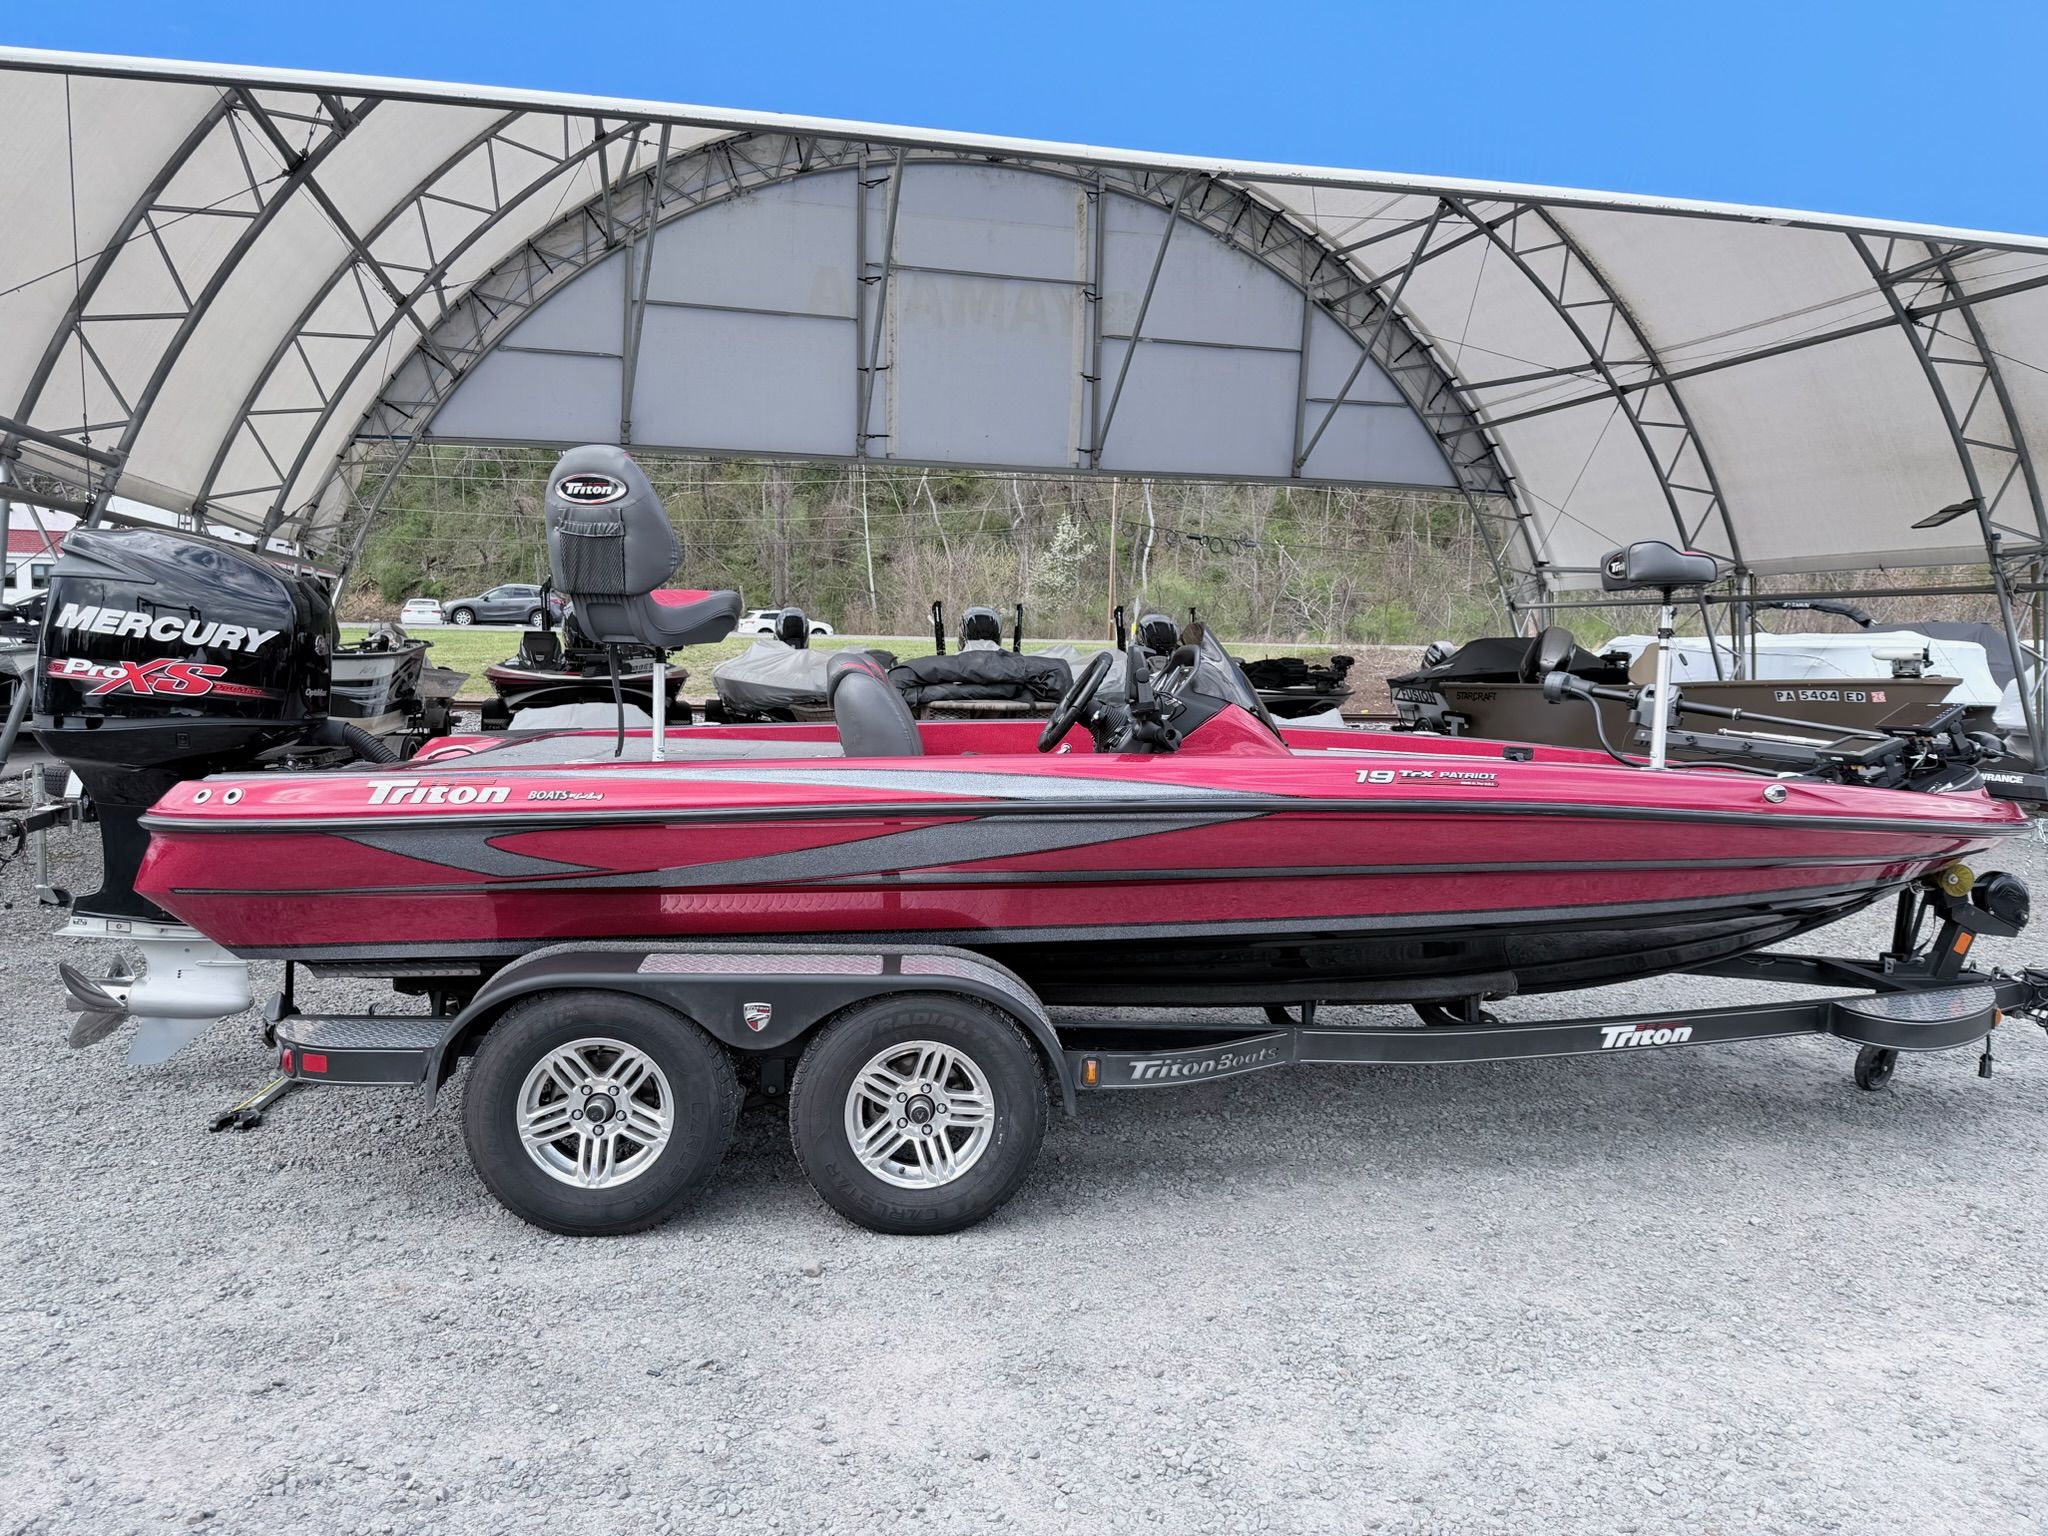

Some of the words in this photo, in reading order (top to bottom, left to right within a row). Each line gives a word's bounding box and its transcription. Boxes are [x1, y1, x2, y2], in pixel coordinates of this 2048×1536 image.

[565, 482, 613, 495] Triton
[55, 603, 280, 653] MERCURY
[1402, 689, 1436, 703] FUSION
[1456, 691, 1497, 702] STARCRAFT
[1776, 691, 1794, 700] PA
[1801, 690, 1838, 700] 5404
[1846, 692, 1865, 702] ED
[1356, 769, 1395, 784] 19
[1439, 771, 1498, 780] PATRIOT
[367, 779, 511, 804] Triton
[528, 790, 568, 800] BOATS
[1601, 1025, 1693, 1049] Triton
